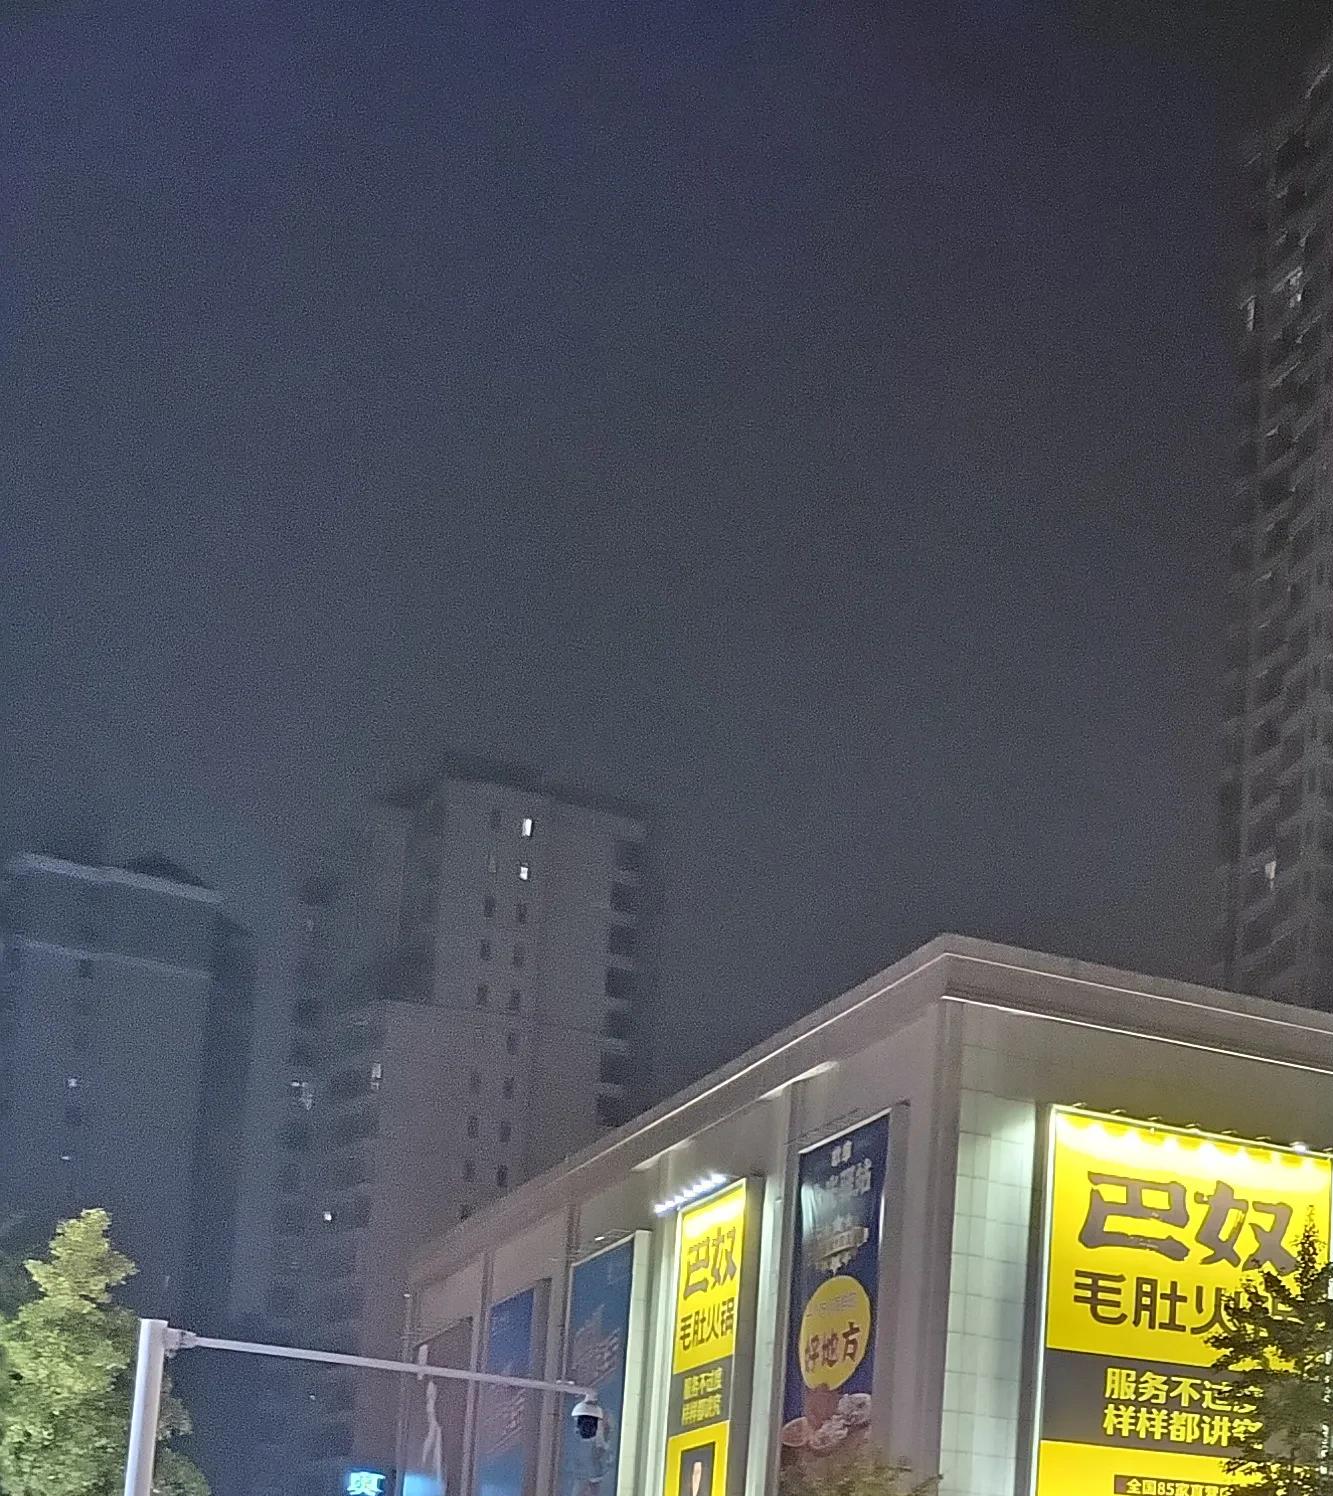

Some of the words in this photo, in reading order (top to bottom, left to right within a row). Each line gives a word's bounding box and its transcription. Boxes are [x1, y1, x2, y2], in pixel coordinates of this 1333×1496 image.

[1078, 1171, 1298, 1276] 巴奴
[683, 1227, 738, 1300] 巴奴
[680, 1297, 736, 1351] 毛肚火锅
[1073, 1269, 1303, 1336] 毛肚火
